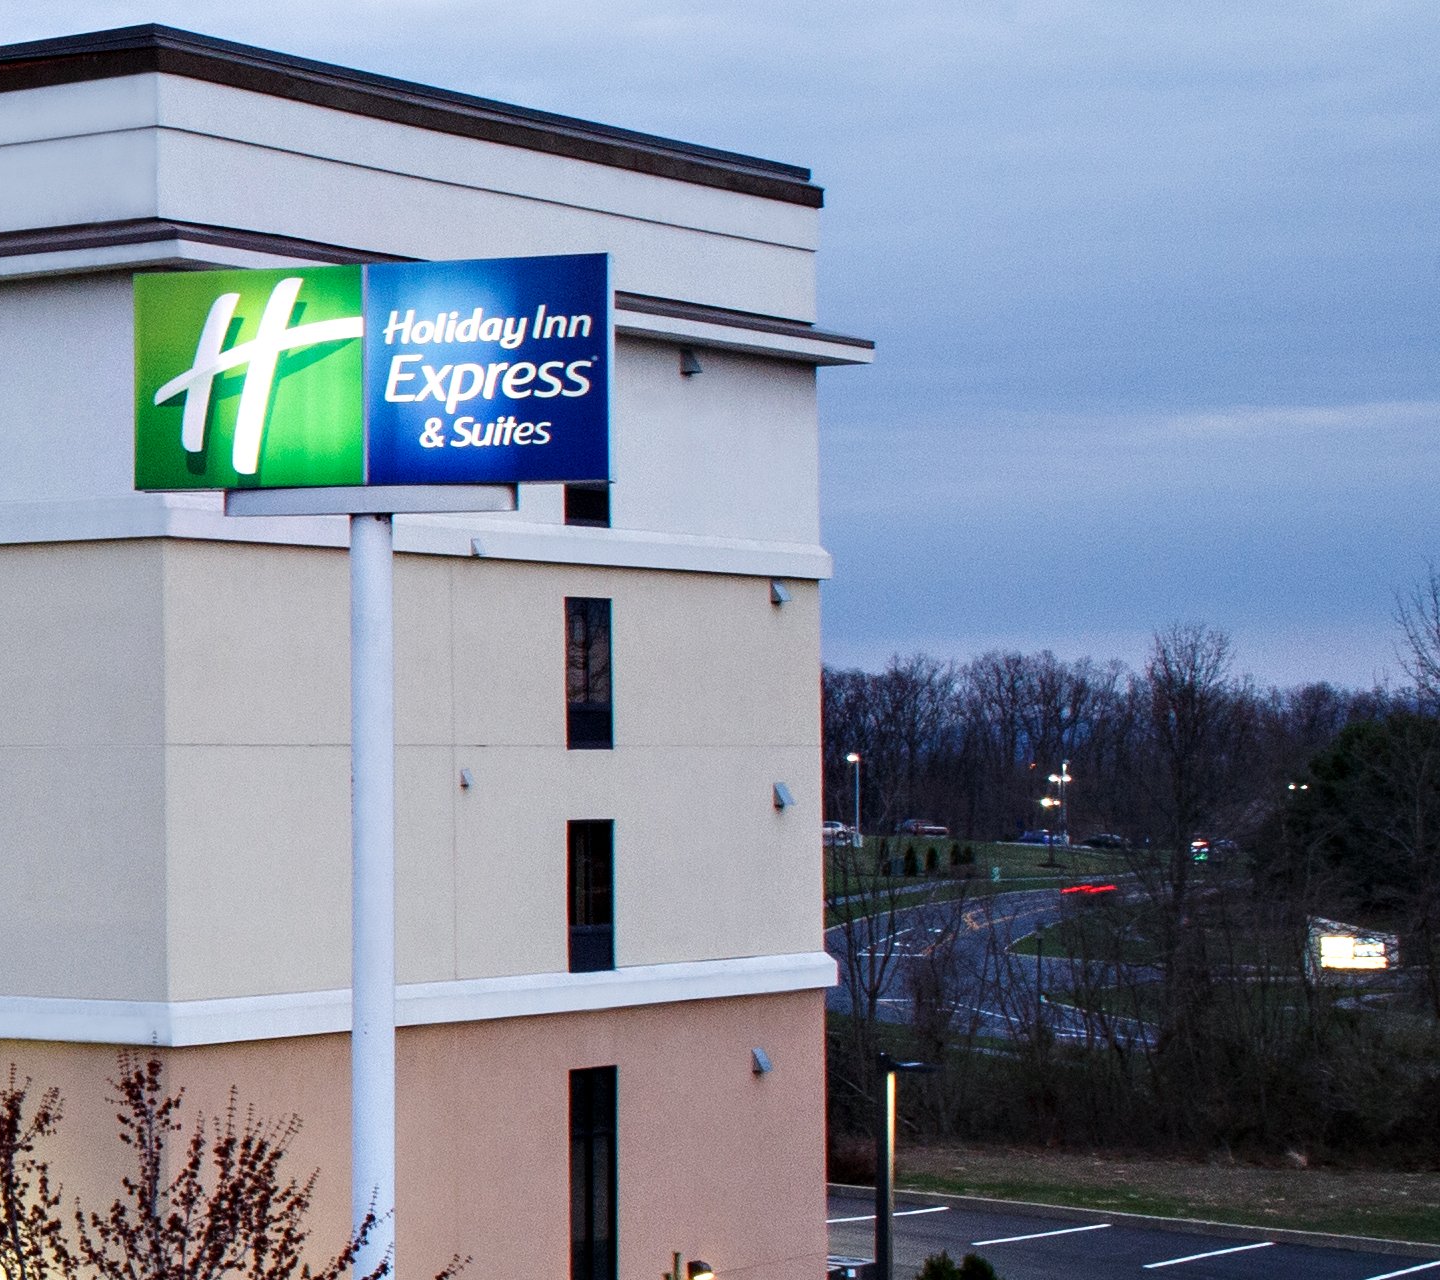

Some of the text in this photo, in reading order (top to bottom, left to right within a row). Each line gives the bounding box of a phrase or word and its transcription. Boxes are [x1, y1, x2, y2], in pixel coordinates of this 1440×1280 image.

[383, 305, 592, 350] Holiday Inn
[384, 354, 593, 414] Express
[419, 415, 551, 449] & Suites
